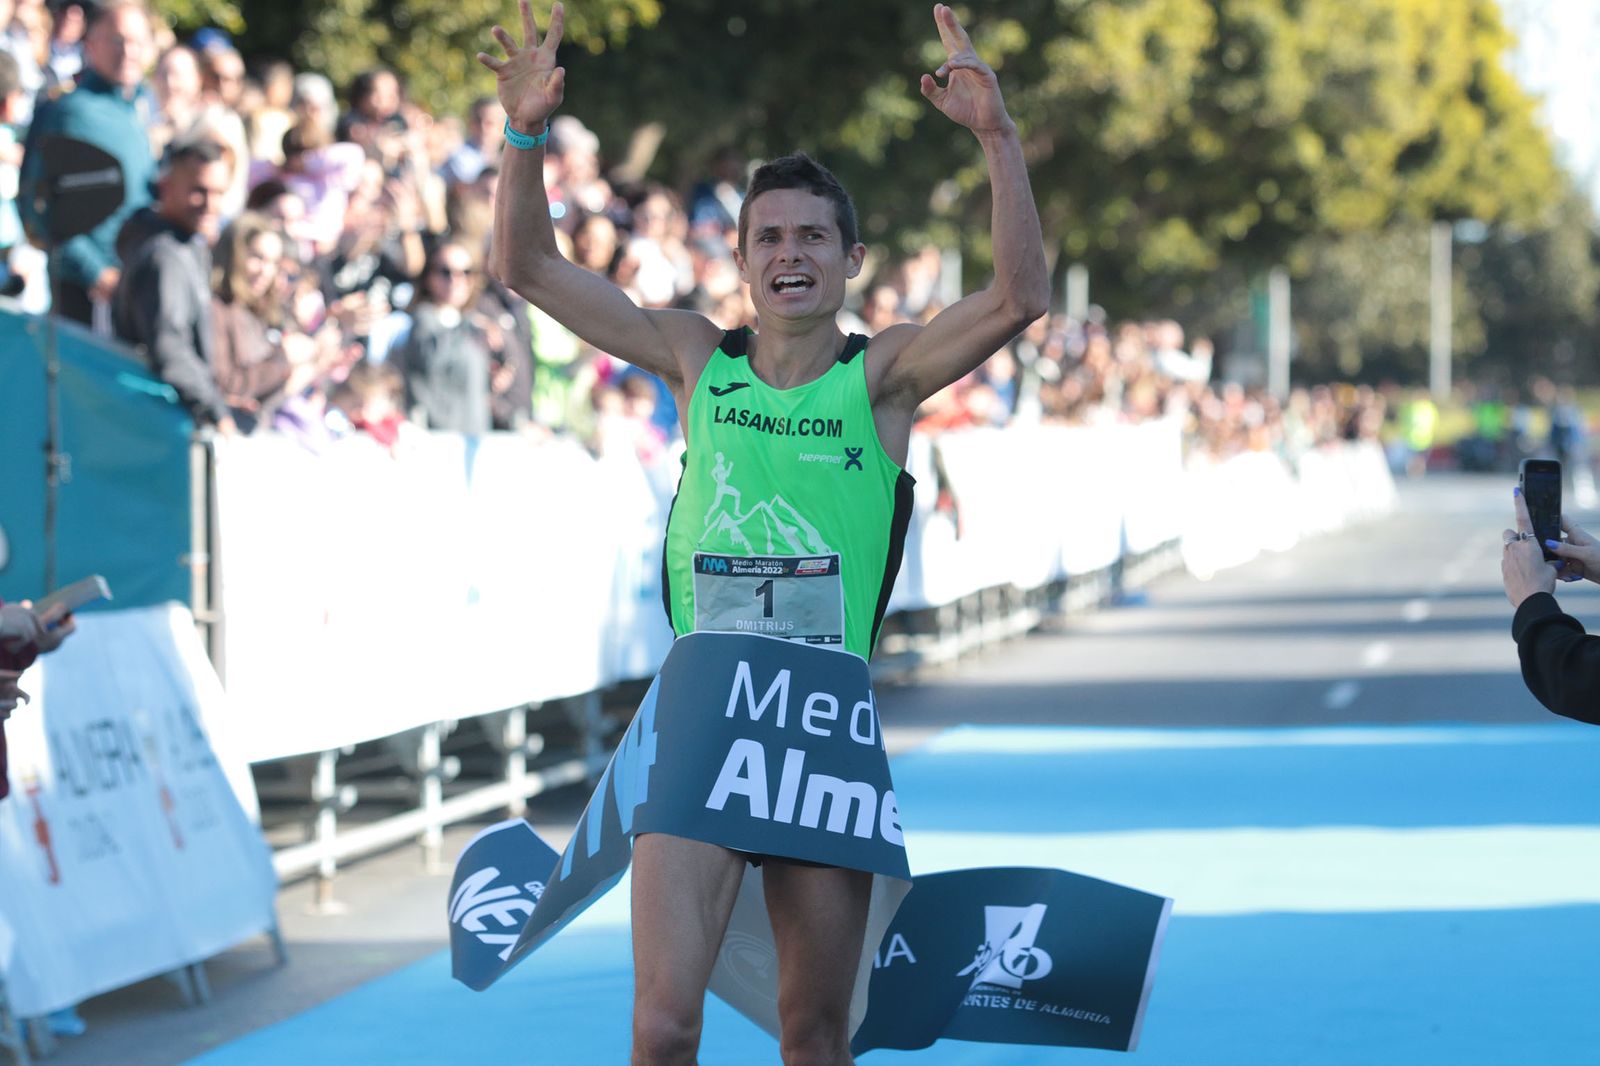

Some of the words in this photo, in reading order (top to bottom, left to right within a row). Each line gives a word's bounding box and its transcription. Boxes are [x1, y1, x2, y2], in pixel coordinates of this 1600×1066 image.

[714, 406, 843, 438] LASANSI.COM
[755, 559, 784, 567] Maratón
[762, 566, 784, 575] 2022
[755, 579, 774, 618] 1
[735, 619, 794, 632] DMITRIJS
[725, 660, 886, 751] Med
[705, 738, 905, 847] Alme
[1013, 998, 1038, 1011] DE
